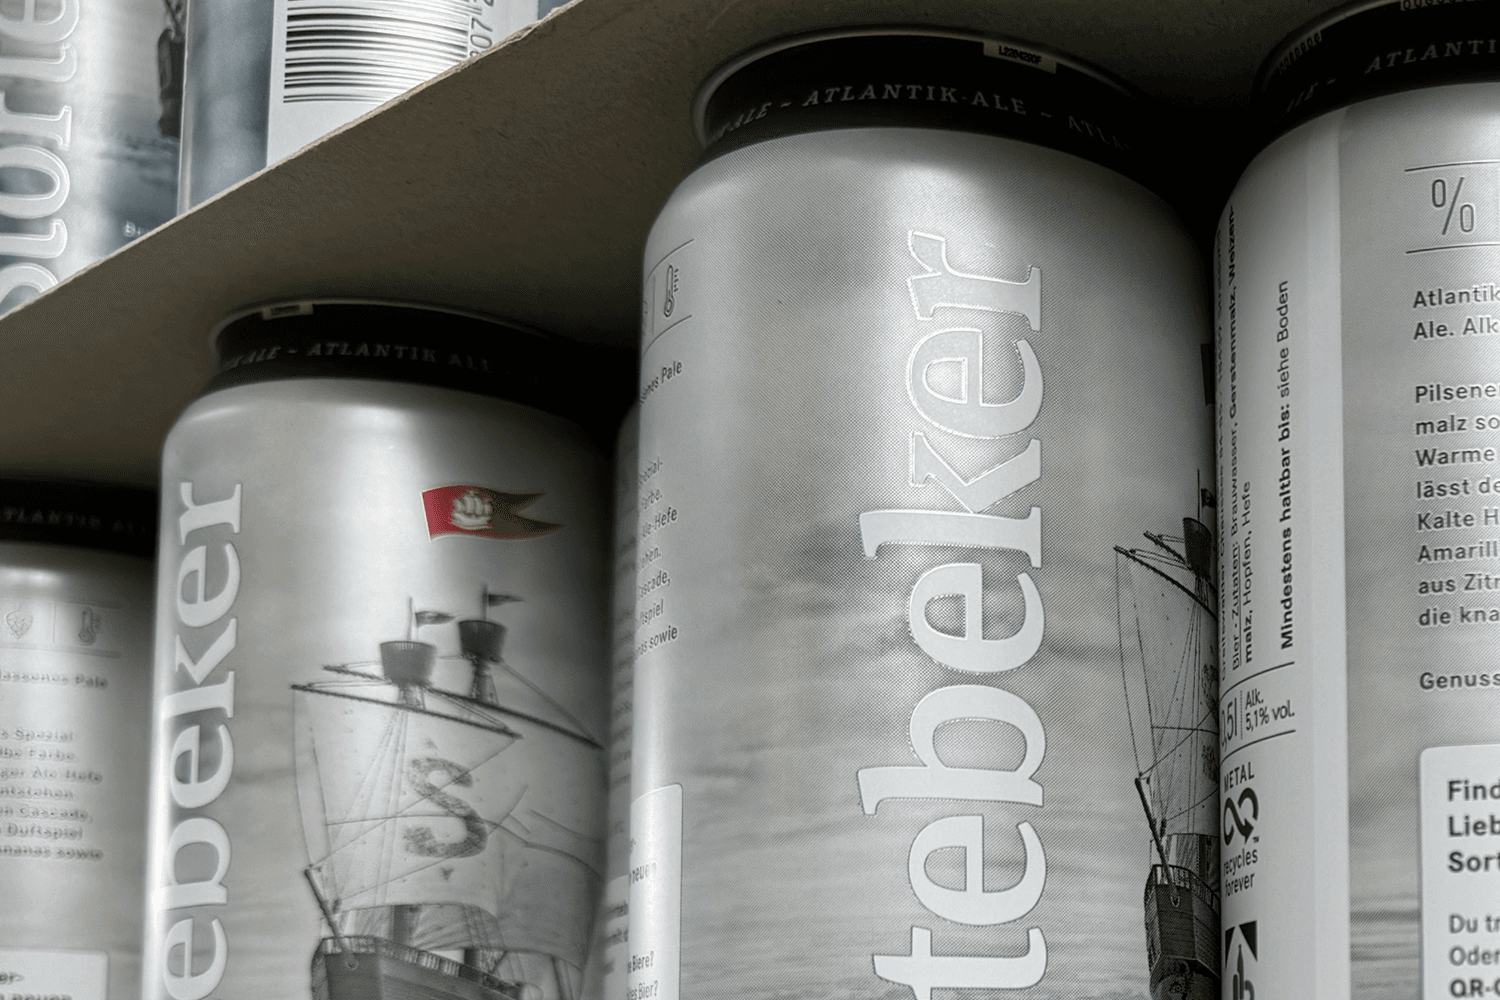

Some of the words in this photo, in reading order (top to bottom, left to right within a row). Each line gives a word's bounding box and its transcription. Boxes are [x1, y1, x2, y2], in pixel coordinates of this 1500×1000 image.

[801, 83, 1028, 115] ATLANTIK-ALE
[1276, 280, 1289, 343] Boden
[1413, 321, 1454, 340] Ale.
[1277, 347, 1290, 398] siehe
[1278, 403, 1291, 442] bis:
[1415, 415, 1467, 435] malz
[1415, 447, 1495, 467] Warme
[1279, 448, 1292, 523] haltbar
[1417, 478, 1469, 499] lässt
[1241, 481, 1251, 526] Hefe
[1417, 509, 1475, 531] Kalte
[1242, 529, 1253, 606] Hopfen,
[1280, 527, 1293, 650] Mindestens
[1418, 578, 1455, 595] aus
[1418, 608, 1451, 627] die
[1243, 608, 1253, 664] malz,
[1244, 687, 1264, 710] Alk.
[1245, 706, 1270, 732] 5,1%
[1271, 700, 1295, 721] vol.
[1223, 848, 1258, 877] recycles
[1224, 872, 1255, 897] forever
[1448, 914, 1478, 933] Du
